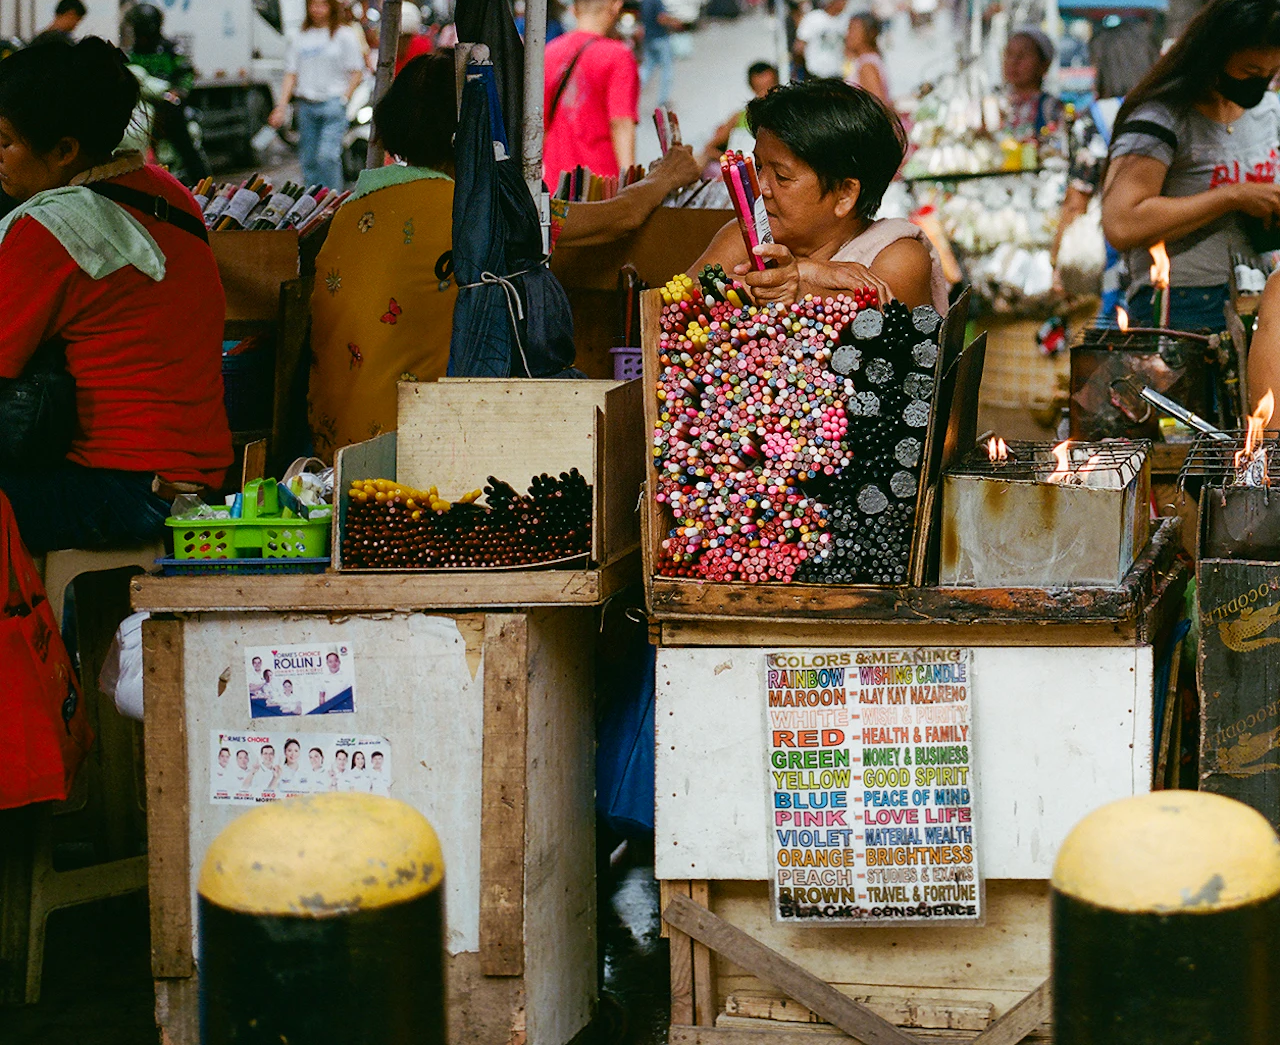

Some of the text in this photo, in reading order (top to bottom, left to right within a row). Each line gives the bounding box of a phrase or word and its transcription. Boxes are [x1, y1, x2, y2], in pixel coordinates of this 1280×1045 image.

[274, 657, 322, 670] ROLLIN J
[775, 649, 960, 668] COLORS & MEANING
[768, 664, 966, 688] RAINBOW WISHING CANDLE
[769, 685, 966, 707] MAROON ALAY KAY NAZARENO
[773, 725, 968, 747] RED HEALTH & FAMILY
[772, 745, 968, 769] GREEN MONEY & BUSINESS
[773, 767, 969, 790] YELLOW GOOD SPIRIT
[775, 788, 970, 809] BLUE PEACE OF MIND
[775, 808, 971, 826] PINK LOVE LIFE
[777, 826, 972, 847] VIOLET MATERIAL WEALTH
[777, 845, 973, 867] ORANGE BRIGHTNESS
[778, 867, 974, 886] PEACH STUDIES & EXAMS
[779, 884, 975, 904] BROWN TRAVEL & FORTUNE
[779, 906, 976, 918] BLACK CONSCIENCE
